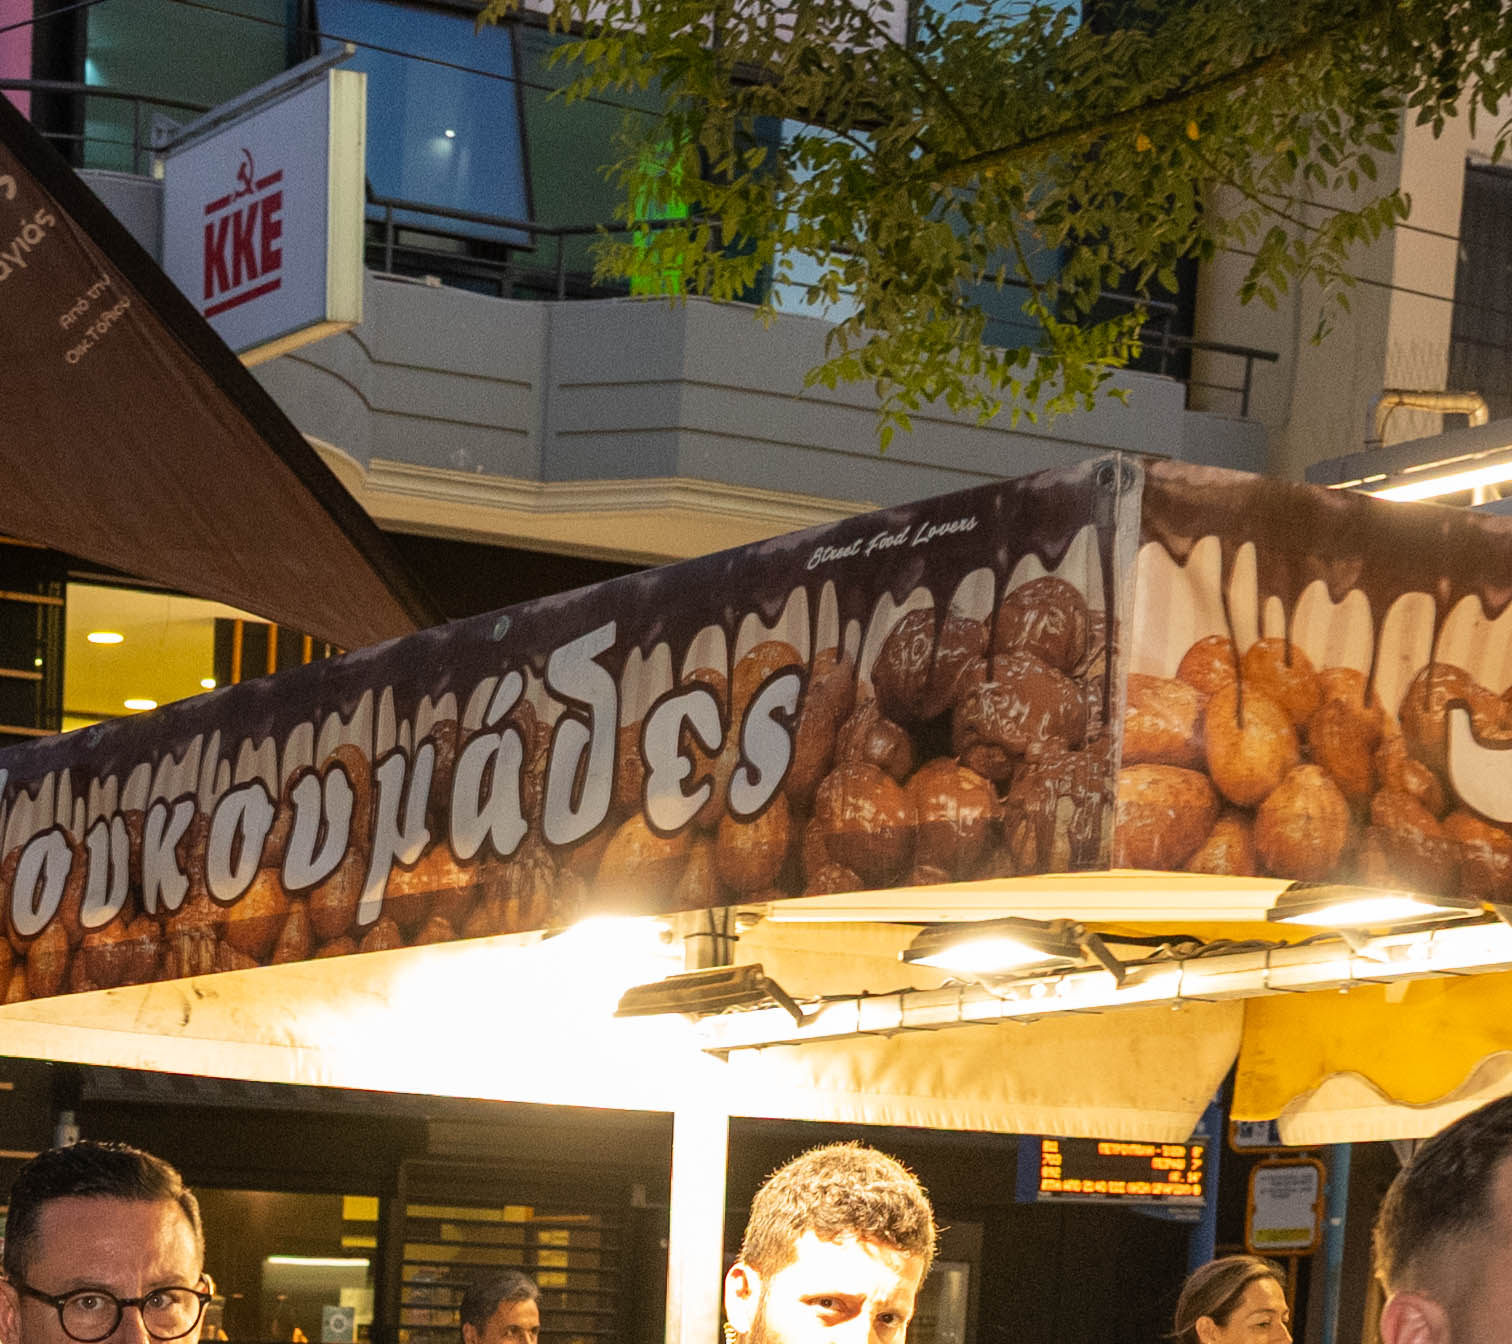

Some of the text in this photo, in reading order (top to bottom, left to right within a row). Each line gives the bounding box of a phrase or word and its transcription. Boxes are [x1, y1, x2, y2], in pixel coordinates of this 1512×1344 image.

[203, 189, 284, 301] ΚΚΕ
[806, 515, 978, 571] Street Food Lovers
